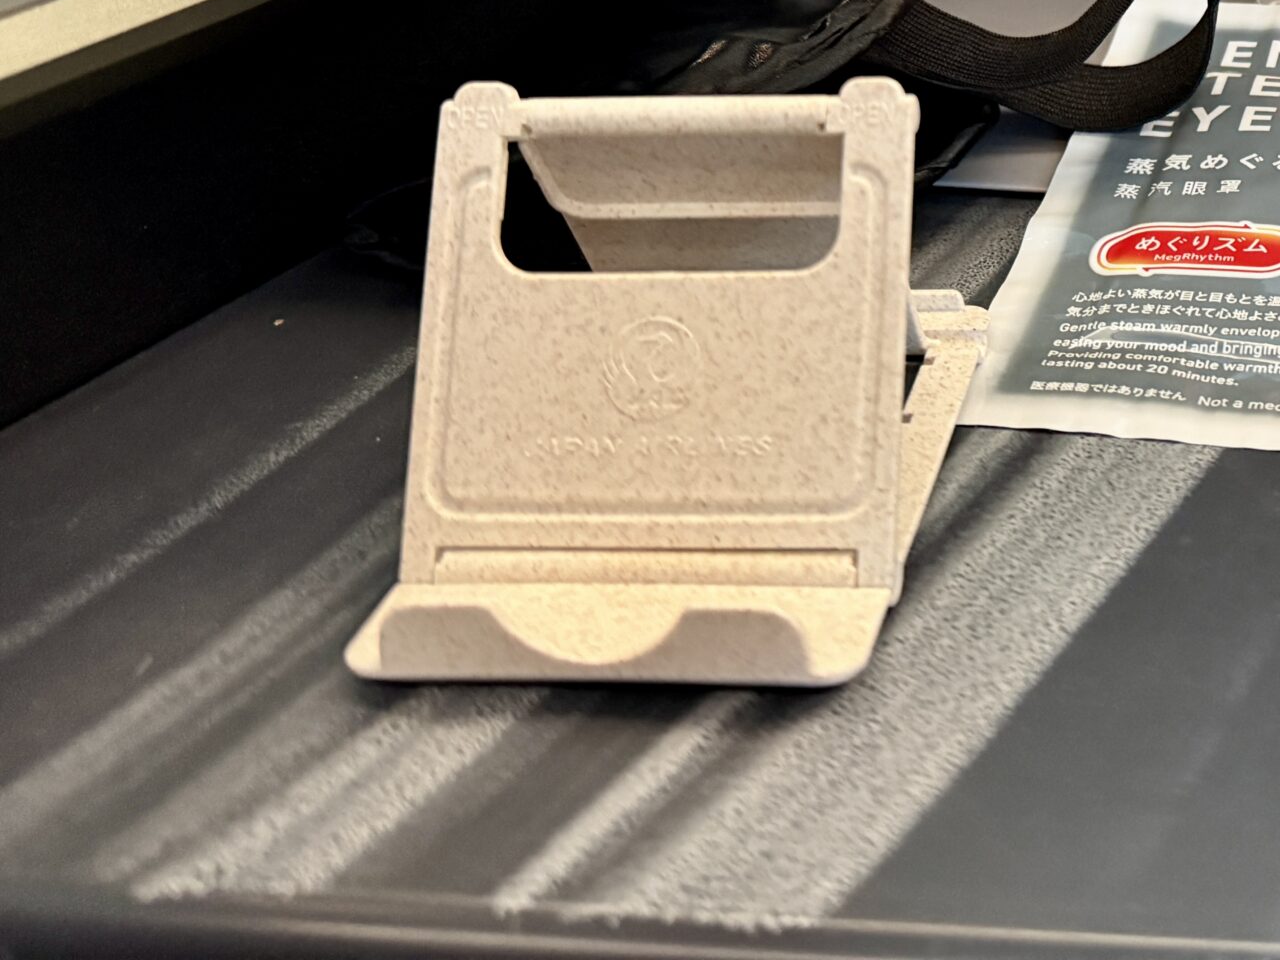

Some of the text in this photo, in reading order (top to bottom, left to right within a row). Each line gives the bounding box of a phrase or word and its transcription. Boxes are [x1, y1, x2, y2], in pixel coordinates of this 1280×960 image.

[1139, 104, 1278, 138] EYE
[1114, 180, 1242, 200] 蒸汽眼罩
[1134, 235, 1269, 253] めぐりズム
[1154, 252, 1235, 263] MegRhythm
[1060, 321, 1107, 333] Gentle
[1110, 321, 1156, 332] steam
[1160, 322, 1217, 335] warmly
[1053, 338, 1104, 350] easing
[1106, 340, 1141, 350] your
[1144, 341, 1188, 353] mood
[1190, 341, 1219, 354] and
[1047, 350, 1121, 360] Providing
[1125, 353, 1219, 371] comfortable
[1041, 359, 1240, 386] lasting about 20 minutes.
[1197, 395, 1230, 408] Not
[1232, 400, 1243, 409] a
